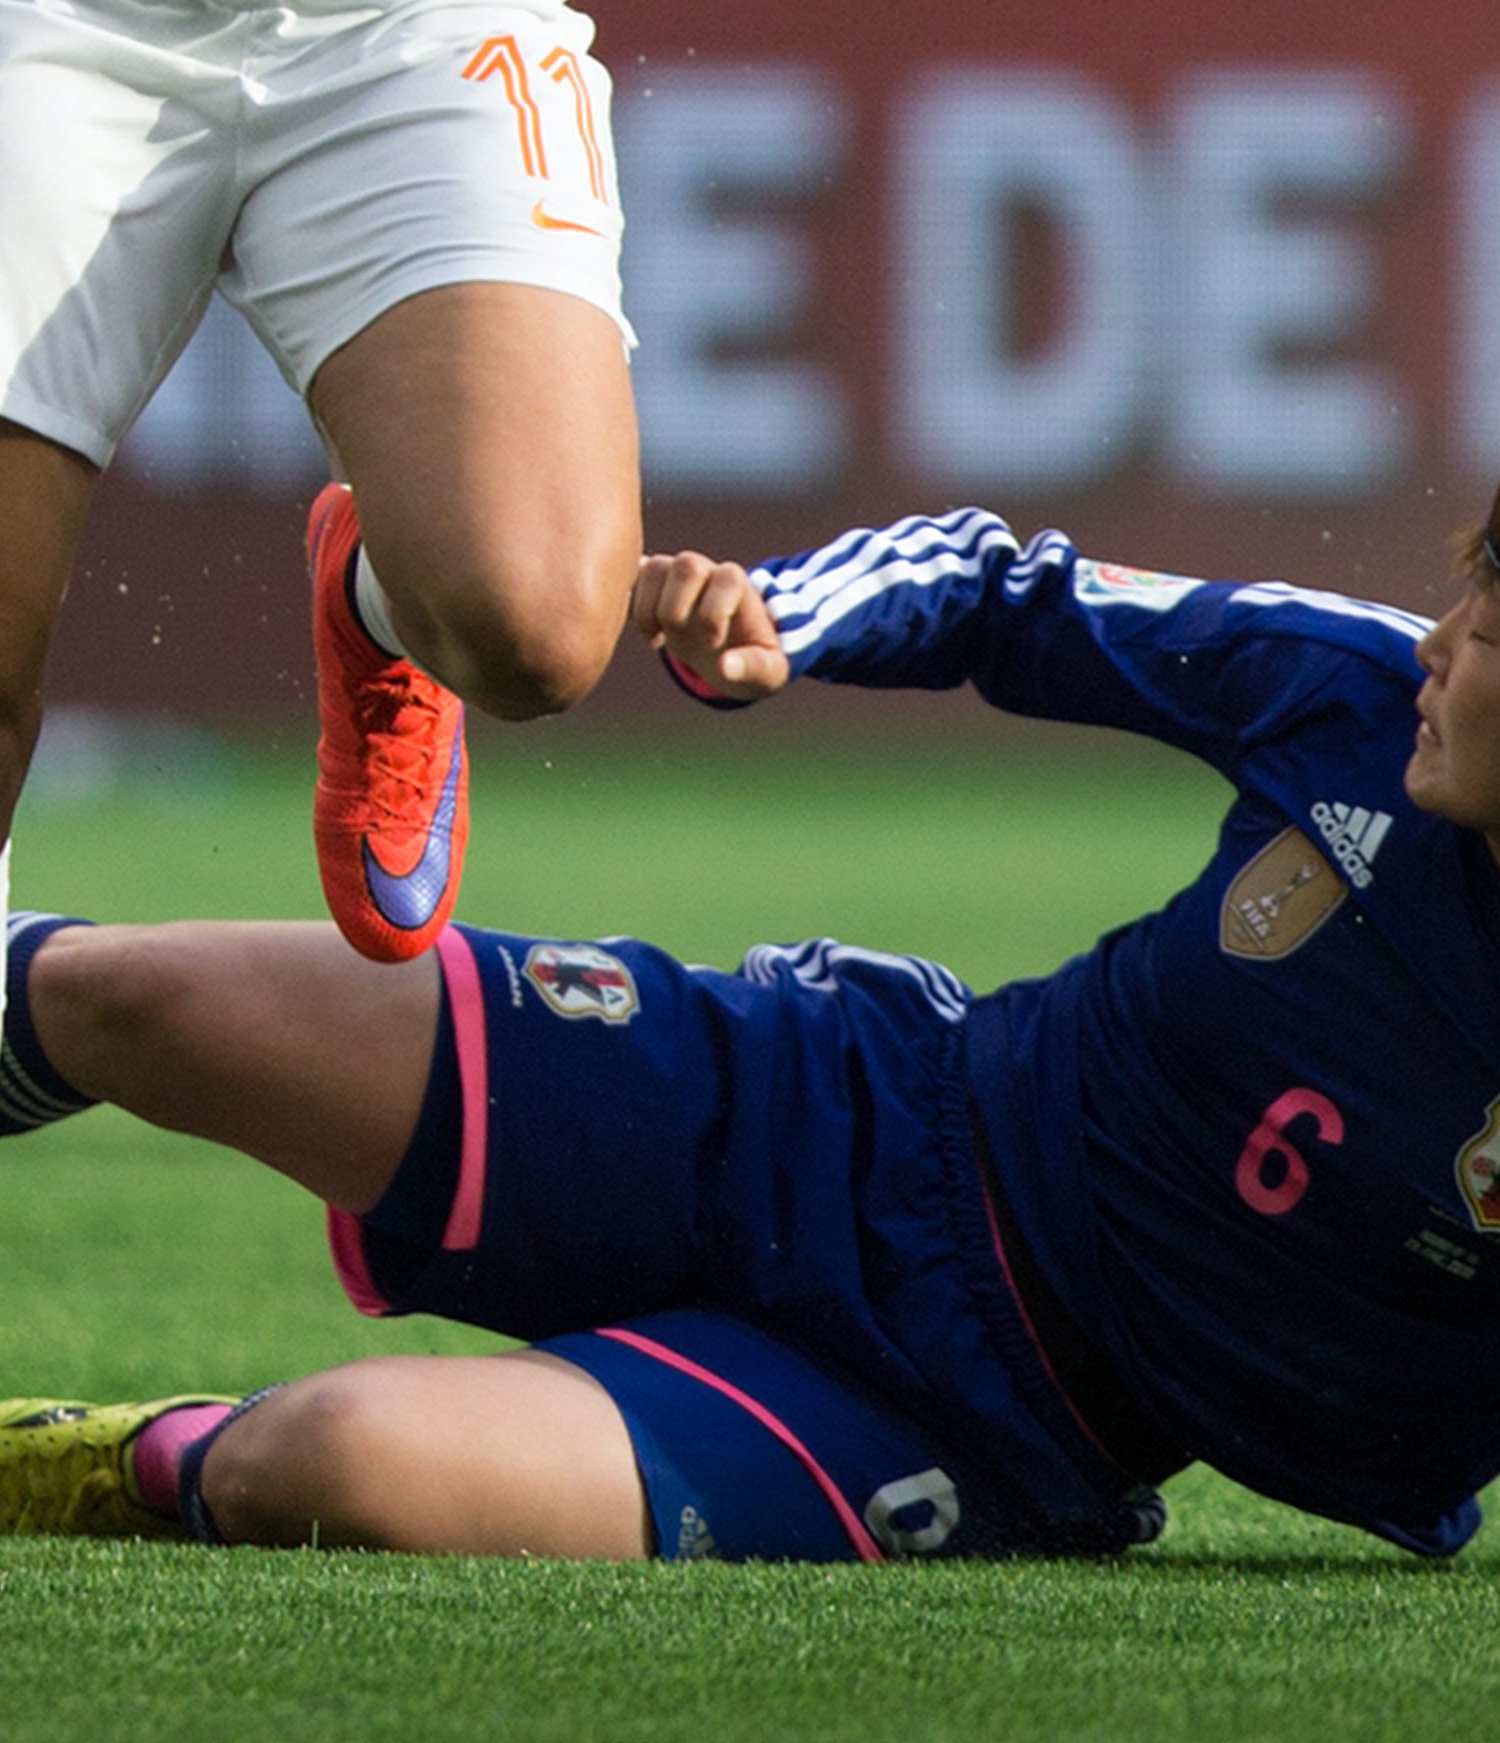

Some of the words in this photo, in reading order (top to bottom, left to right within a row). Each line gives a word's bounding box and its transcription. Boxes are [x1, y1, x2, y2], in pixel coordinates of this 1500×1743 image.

[461, 34, 608, 206] 11
[885, 64, 1412, 491] DE
[1310, 801, 1373, 888] adidas
[1235, 1087, 1345, 1215] 6
